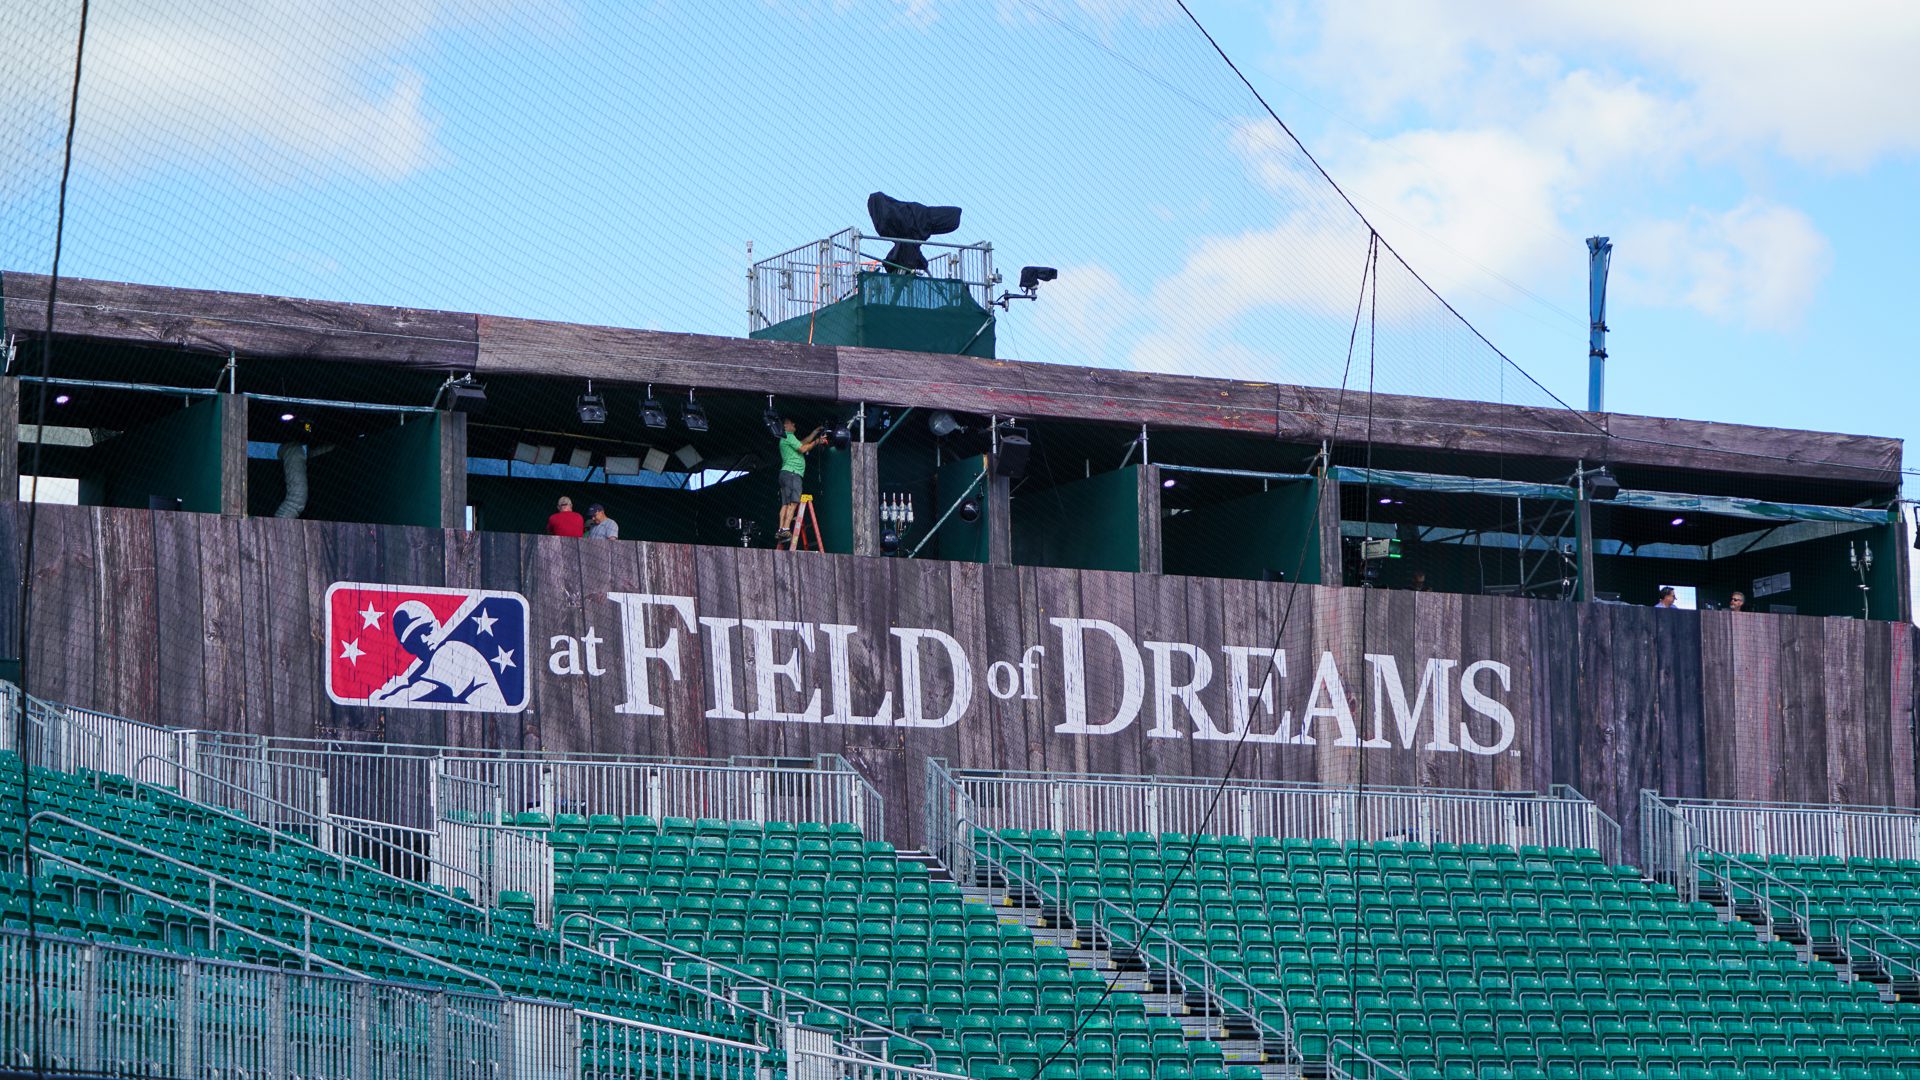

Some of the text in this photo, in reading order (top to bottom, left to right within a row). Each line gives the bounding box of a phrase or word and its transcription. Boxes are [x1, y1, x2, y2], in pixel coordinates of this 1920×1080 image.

[548, 626, 607, 677] at
[606, 591, 973, 729] FIELD
[986, 645, 1045, 700] of
[1049, 616, 1516, 756] DREAMS
